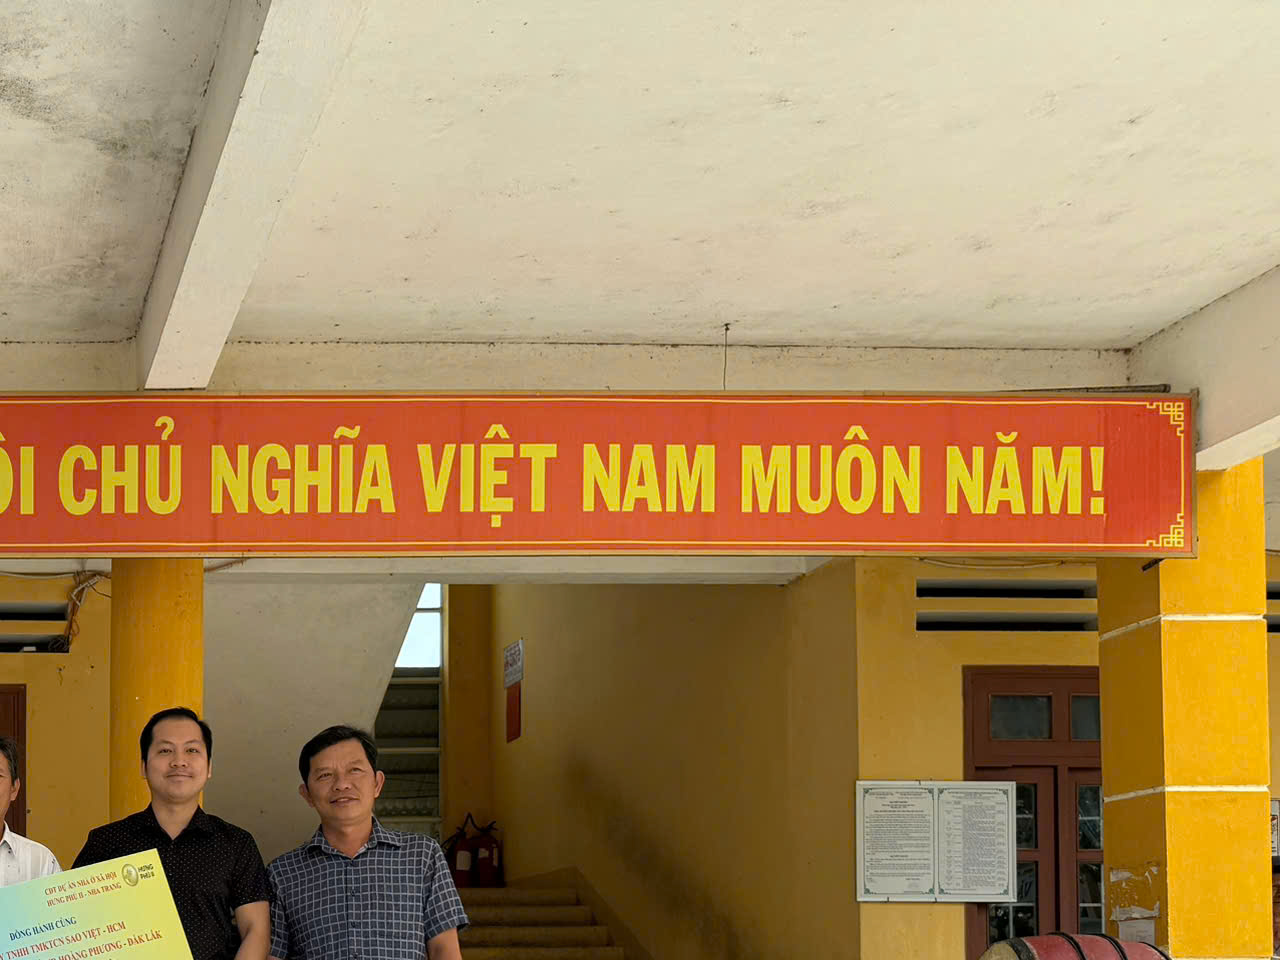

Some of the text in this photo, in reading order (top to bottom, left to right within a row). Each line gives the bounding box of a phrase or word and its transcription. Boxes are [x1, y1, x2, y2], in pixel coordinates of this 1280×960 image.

[57, 416, 182, 517] CHỦ
[211, 424, 396, 516] NGHĨA
[417, 424, 558, 528] VIỆT
[581, 443, 716, 515] NAM
[740, 425, 921, 515] MUÔN
[945, 431, 1107, 520] NĂM!
[100, 881, 121, 892] TRANG
[54, 916, 76, 928] CÙNG
[5, 946, 29, 960] TNHH
[29, 936, 64, 953] TMKTCN
[64, 932, 81, 944] SAO
[81, 927, 101, 939] VIỆT
[106, 921, 126, 933] HCM
[87, 940, 122, 956] PHƯƠNG
